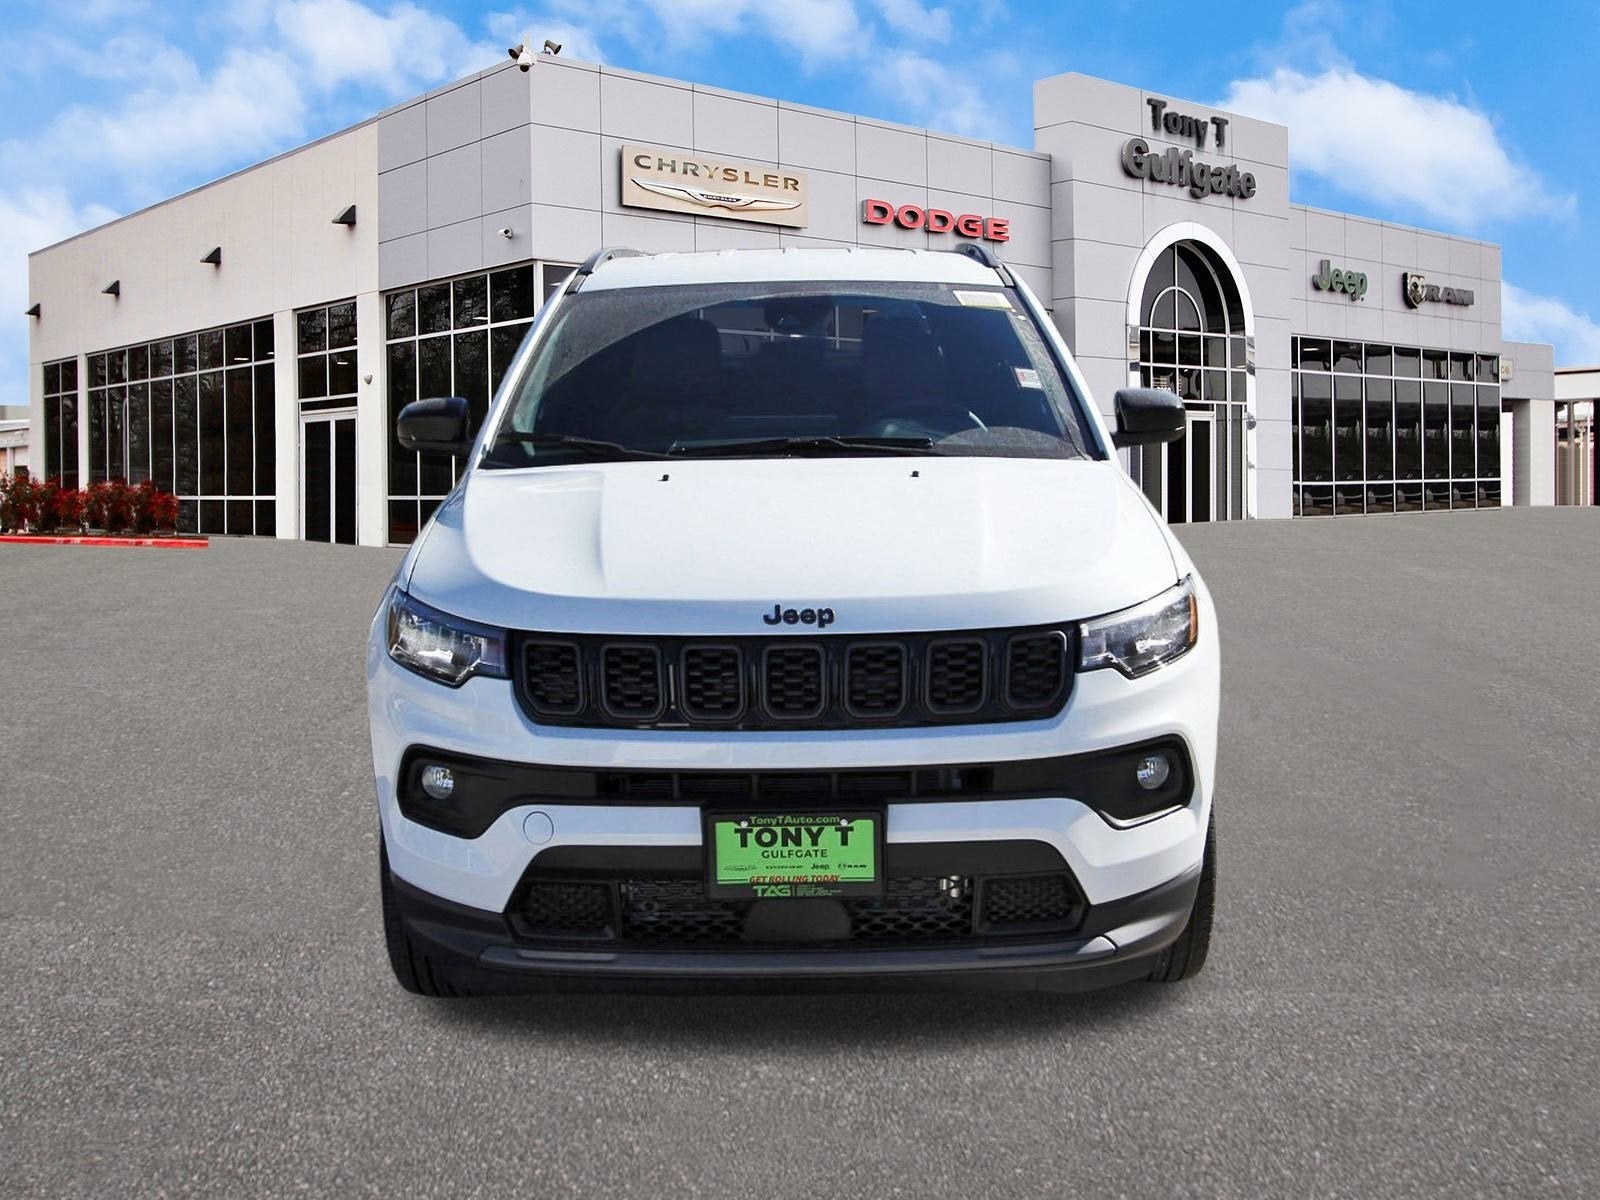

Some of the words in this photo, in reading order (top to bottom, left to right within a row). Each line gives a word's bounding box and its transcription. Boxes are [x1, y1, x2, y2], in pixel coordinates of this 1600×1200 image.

[1147, 98, 1208, 148] Tony
[1211, 117, 1229, 147] T
[633, 154, 800, 191] CHRYSLER
[1121, 138, 1256, 198] Gulfgate
[863, 198, 1010, 242] DODGE
[1312, 259, 1368, 301] Jeep
[1425, 284, 1474, 306] RAM
[763, 604, 835, 628] Jeep
[750, 816, 840, 826] TonyTAuto.com
[734, 827, 825, 848] TONY
[835, 826, 854, 847] T
[761, 849, 828, 859] GULFGATE
[751, 876, 767, 884] GET
[769, 875, 808, 884] ROLLING
[811, 874, 840, 884] TODAY
[752, 885, 791, 896] TAG
